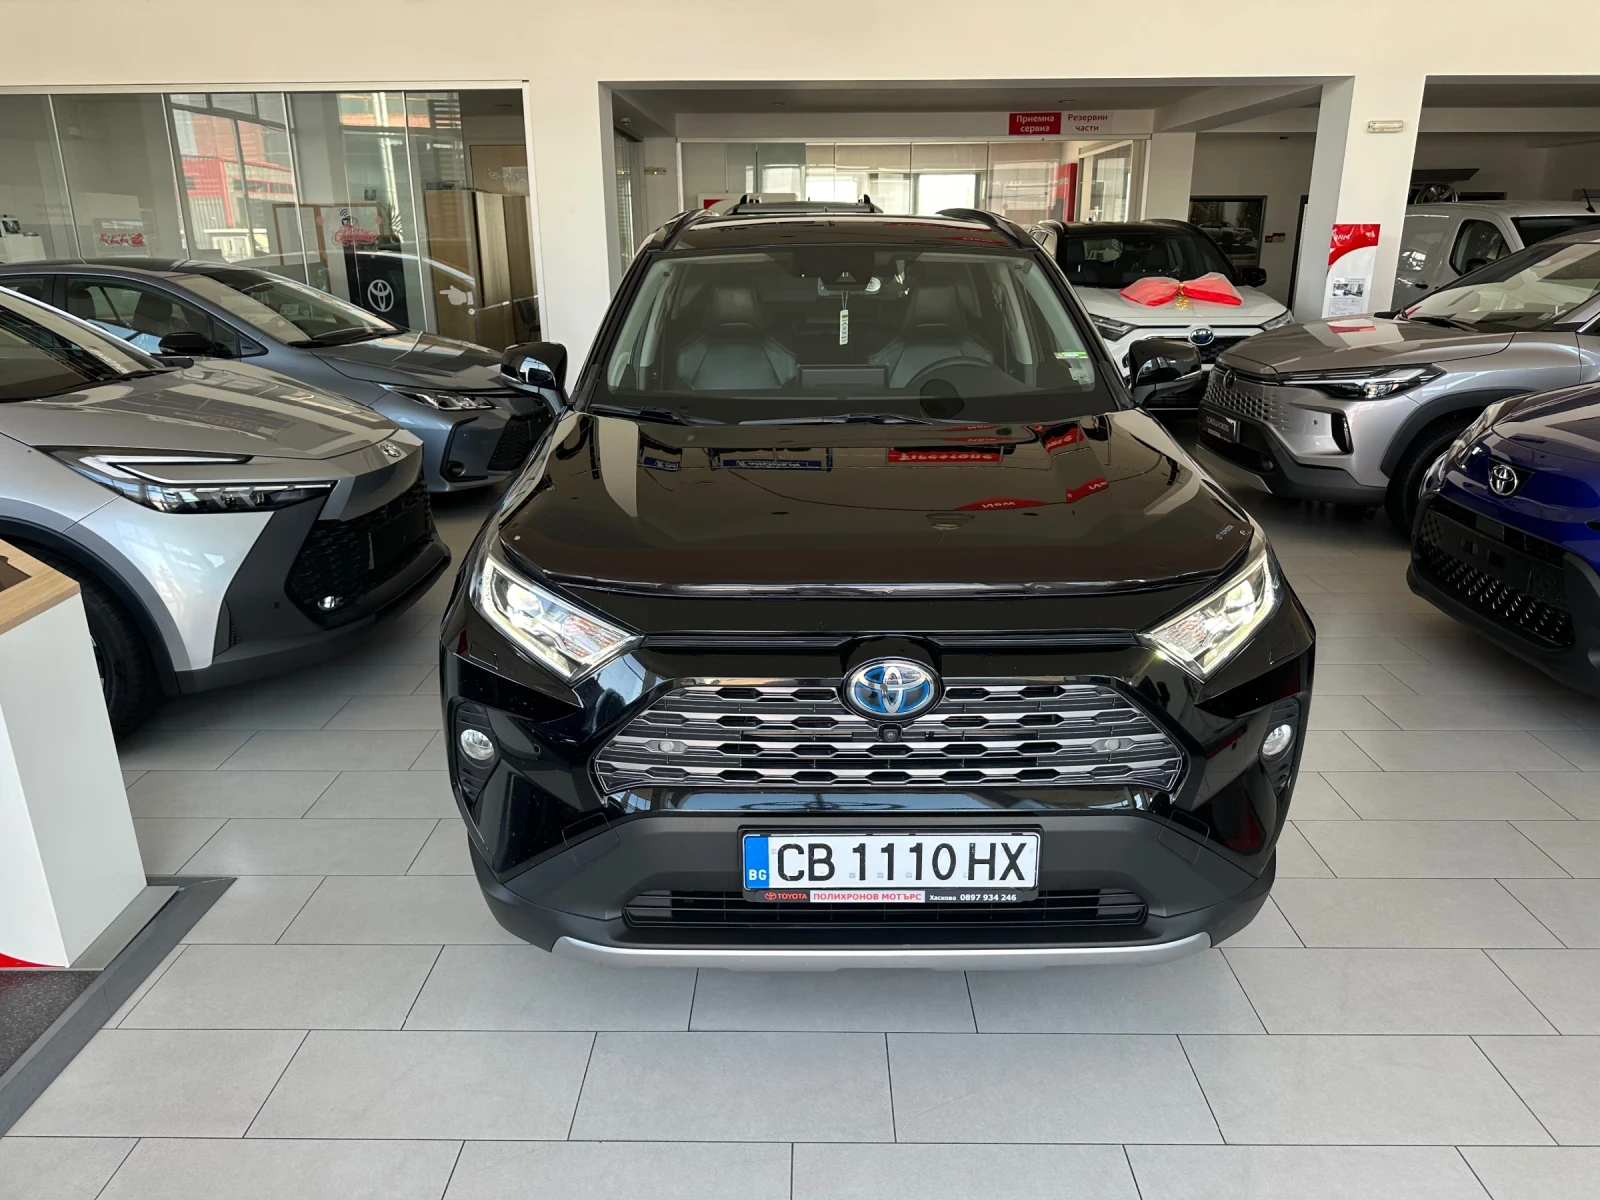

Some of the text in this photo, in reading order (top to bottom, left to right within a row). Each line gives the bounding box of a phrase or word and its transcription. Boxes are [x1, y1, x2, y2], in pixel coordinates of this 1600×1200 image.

[1016, 114, 1055, 124] Приемна
[1067, 113, 1108, 122] Резервни
[1020, 125, 1050, 133] сервиз
[777, 842, 1027, 882] CB 1110 HX
[748, 869, 767, 881] BG
[960, 893, 980, 901] 0897
[982, 893, 999, 901] 934
[1000, 893, 1017, 901] 246
